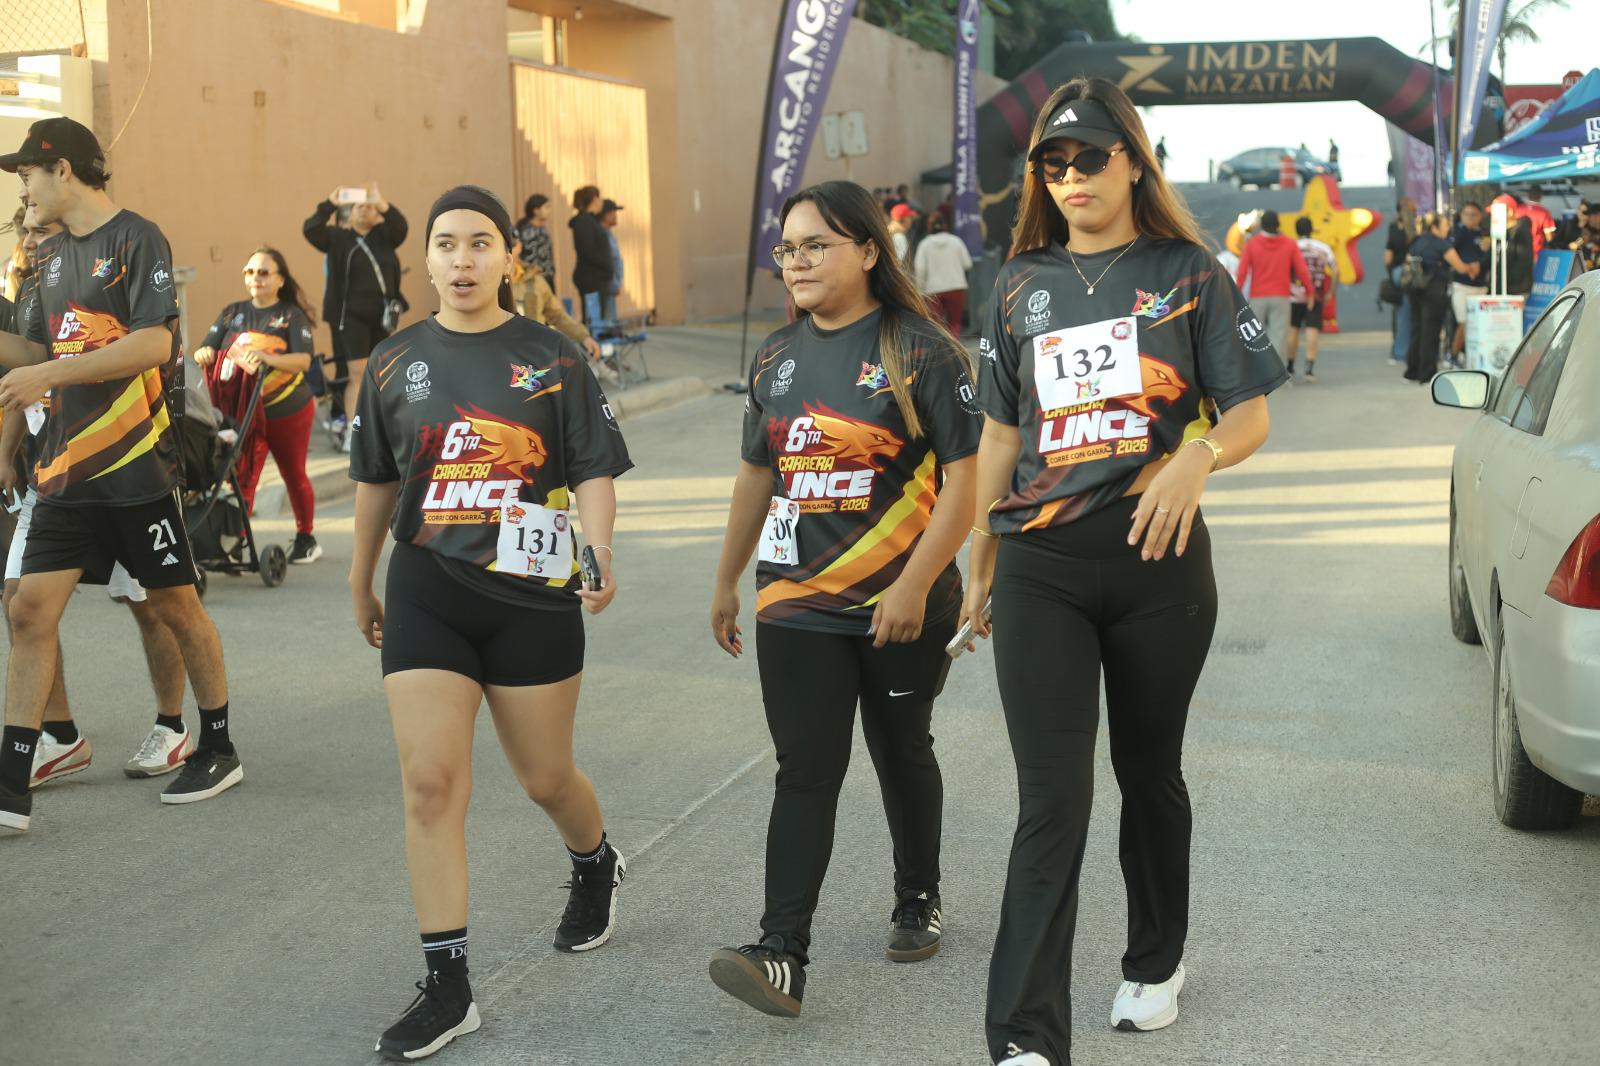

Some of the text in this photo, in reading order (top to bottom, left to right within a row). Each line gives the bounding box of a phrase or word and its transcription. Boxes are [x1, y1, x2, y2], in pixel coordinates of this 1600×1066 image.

[807, 0, 845, 95] RESIDENC
[1187, 40, 1338, 71] IMDEM
[771, 0, 833, 194] ARCANG
[1053, 344, 1117, 380] 132
[441, 421, 482, 460] 6TA
[785, 416, 823, 452] 6TA
[1038, 409, 1151, 453] LINCE
[778, 455, 836, 472] CARRERA
[1070, 452, 1085, 460] CON
[1086, 447, 1109, 457] GARRA
[1115, 438, 1149, 455] 2026
[432, 463, 493, 480] CARRERA
[781, 469, 876, 499] INCE
[421, 479, 523, 510] LINCE
[840, 497, 871, 511] 2026
[148, 518, 177, 551] 21
[516, 527, 559, 556] 131
